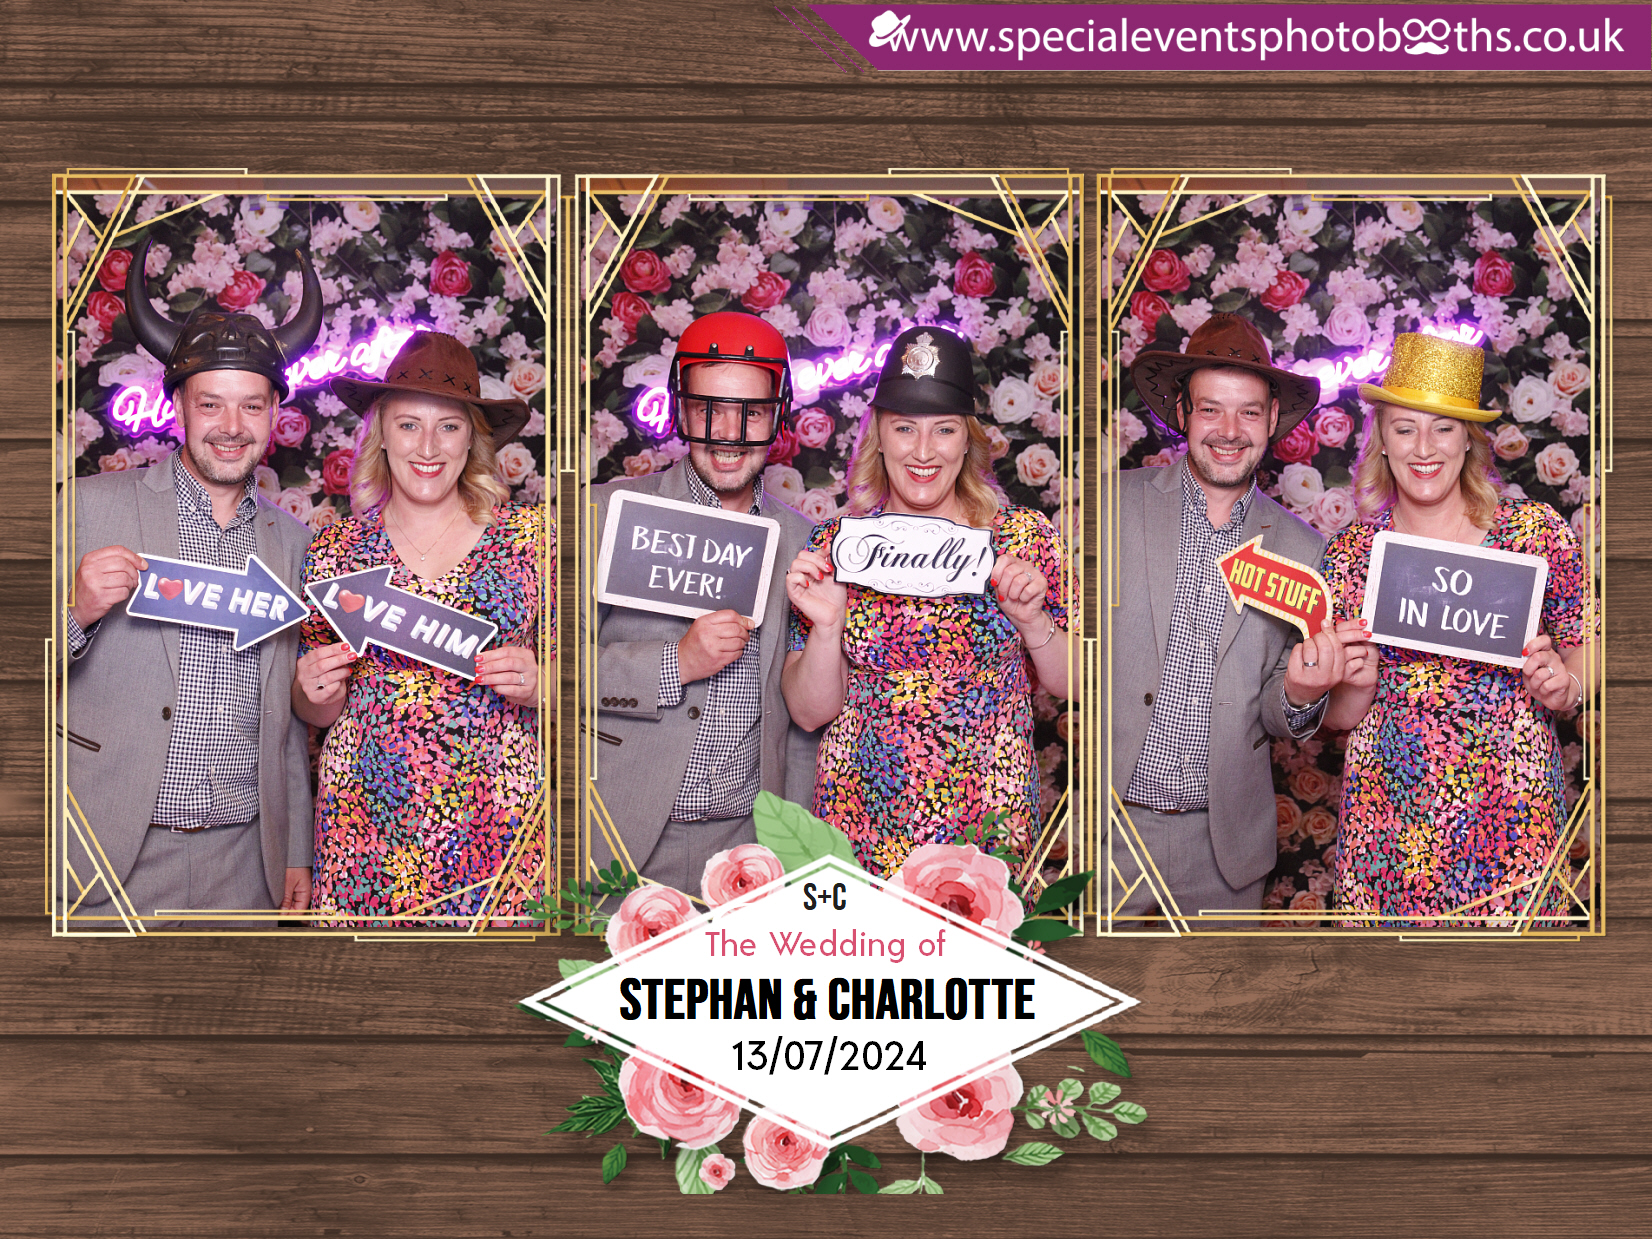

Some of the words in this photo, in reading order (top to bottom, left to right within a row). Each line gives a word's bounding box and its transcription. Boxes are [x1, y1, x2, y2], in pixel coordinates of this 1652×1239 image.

[632, 525, 697, 559] BEST
[702, 539, 753, 569] DAY
[838, 533, 987, 582] Finally!
[648, 565, 724, 600] EVER!
[1229, 558, 1266, 593] HOT
[1265, 572, 1322, 614] STUFF
[1432, 566, 1473, 596] SO
[228, 587, 289, 622] HER
[1399, 597, 1428, 628] IN
[1441, 608, 1509, 639] LOVE
[410, 614, 480, 660] HIM
